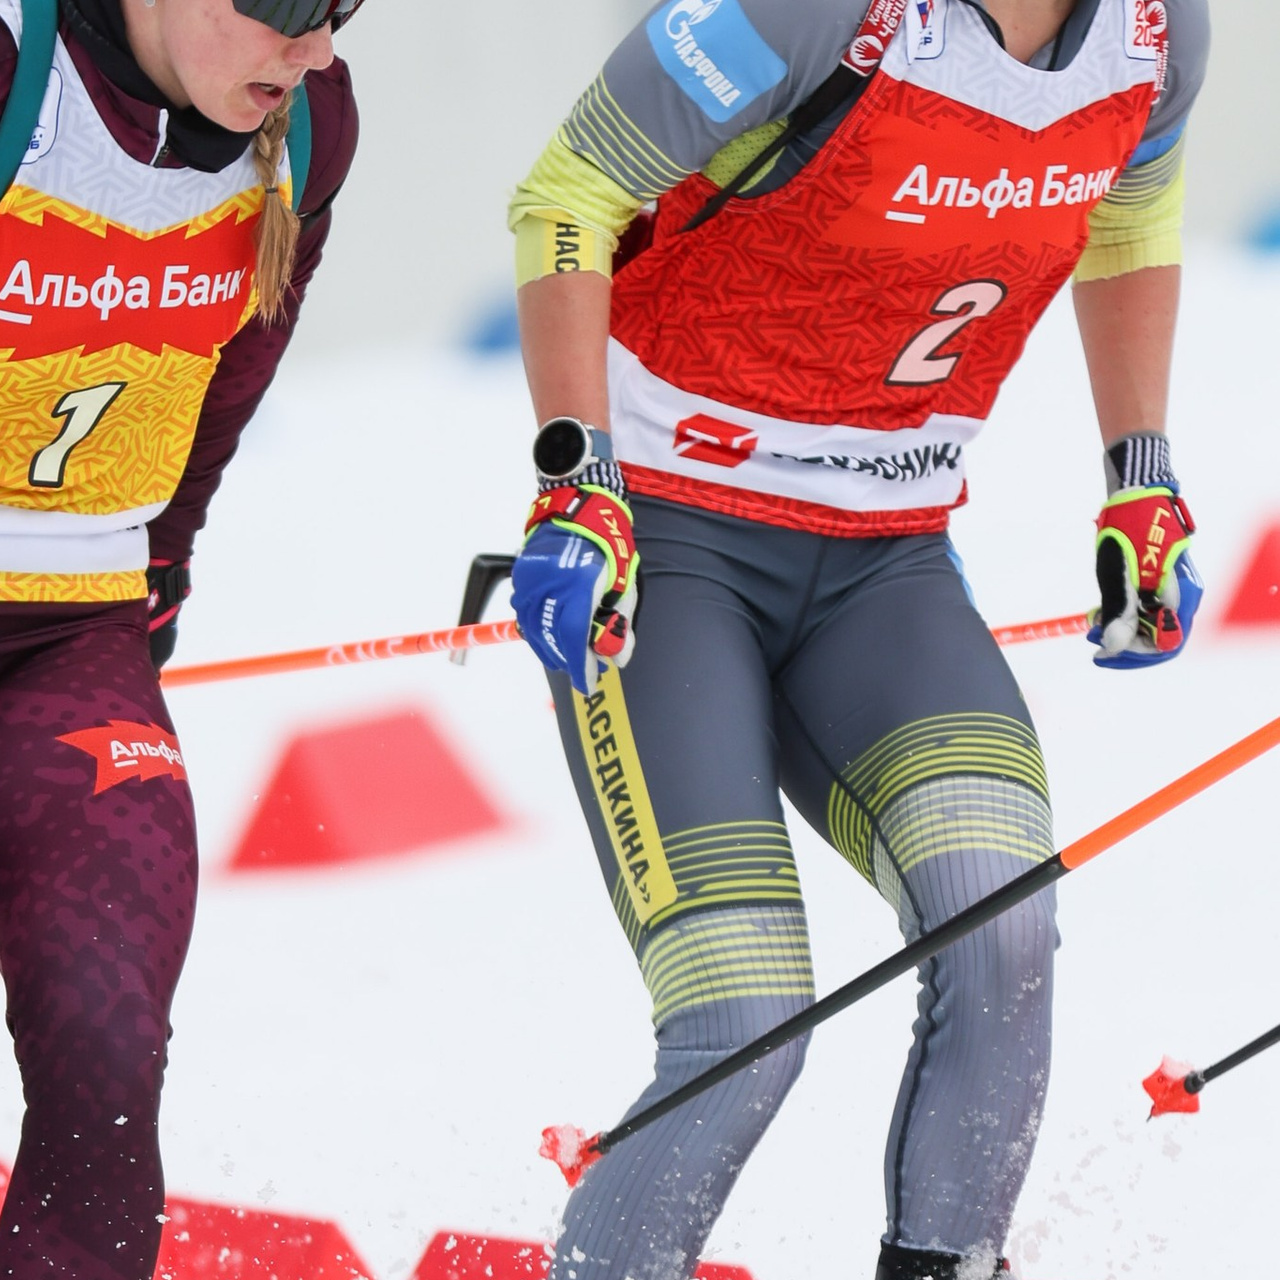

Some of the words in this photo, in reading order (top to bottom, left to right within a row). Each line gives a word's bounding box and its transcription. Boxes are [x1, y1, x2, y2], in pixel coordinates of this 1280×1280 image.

[891, 164, 1034, 218] Альфа
[1039, 165, 1118, 207] Банк
[159, 265, 247, 308] Банк
[883, 277, 1009, 387] 2
[27, 381, 129, 489] 1
[599, 508, 629, 585] LEKI
[1141, 506, 1171, 578] LEKI
[110, 740, 184, 766] Альфа
[584, 677, 651, 904] АСЕДКИНА»
